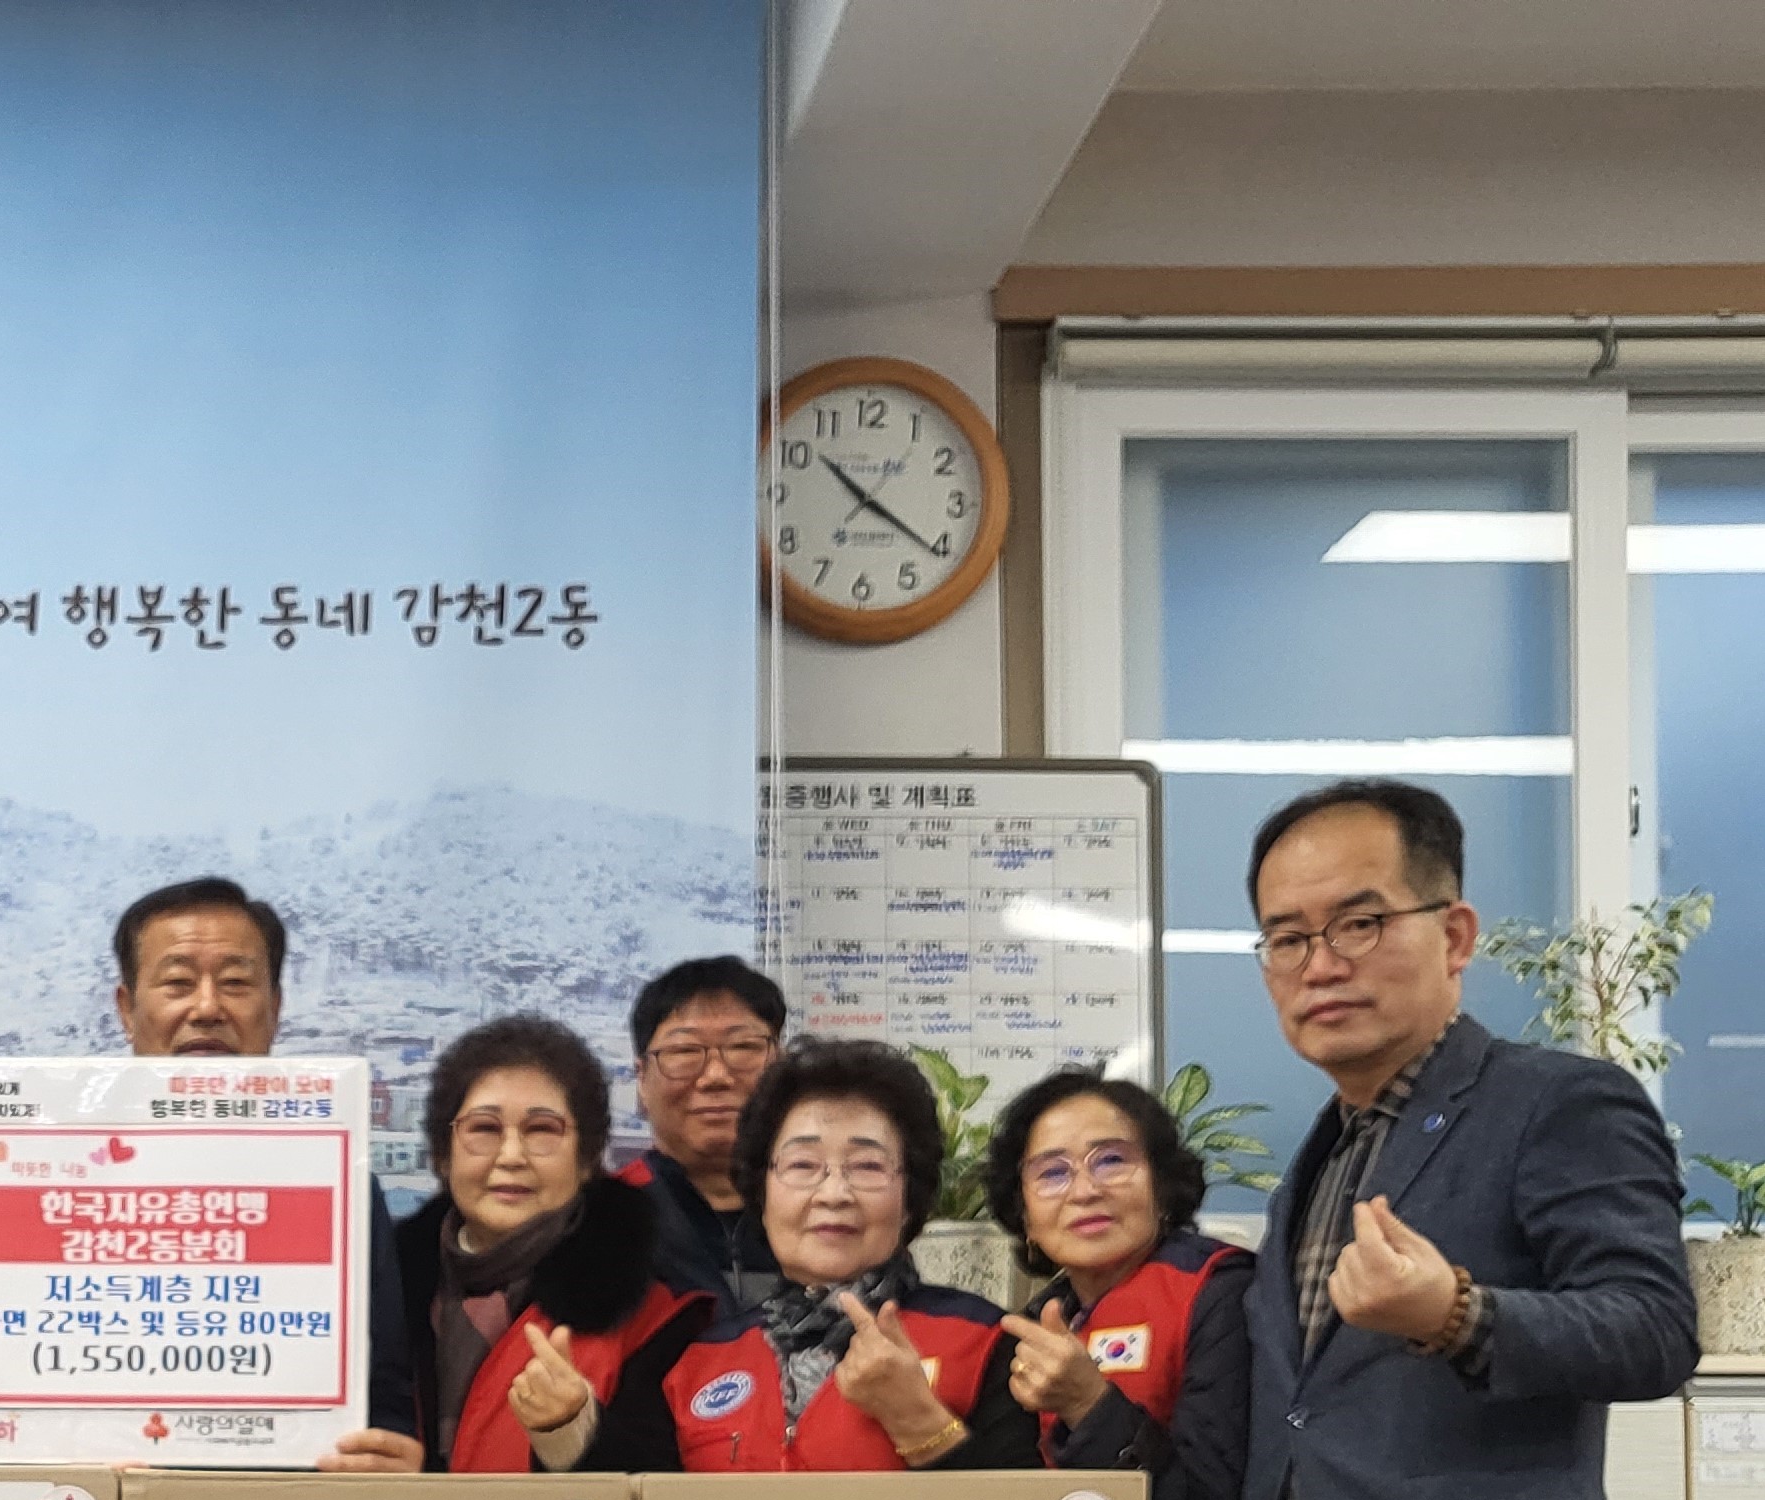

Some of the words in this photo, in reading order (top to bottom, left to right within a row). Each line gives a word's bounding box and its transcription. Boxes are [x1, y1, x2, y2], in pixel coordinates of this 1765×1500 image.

[814, 409, 840, 439] 11
[857, 400, 888, 429] 12
[909, 413, 921, 442] 1
[781, 441, 811, 469] 10
[934, 447, 956, 476] 2
[947, 491, 966, 519] 3
[779, 527, 799, 554] 8
[931, 532, 951, 558] 4
[813, 559, 833, 586] 7
[898, 563, 920, 590] 5
[851, 574, 874, 601] 6
[63, 583, 242, 652] 행복한
[259, 584, 371, 650] 동네
[394, 582, 598, 650] 감천2동
[902, 784, 978, 809] 계획표
[40, 1190, 269, 1226] 한국자유총연맹
[61, 1229, 247, 1264] 감천2동분회
[45, 1274, 192, 1303] 저소득계층
[206, 1274, 261, 1303] 지원
[38, 1310, 129, 1337] 22박스
[141, 1311, 164, 1337] 및
[175, 1311, 227, 1336] 등유
[238, 1309, 332, 1337] 80만원
[32, 1343, 272, 1376] (1,550,000원)
[175, 1413, 274, 1436] 사랑의열매
